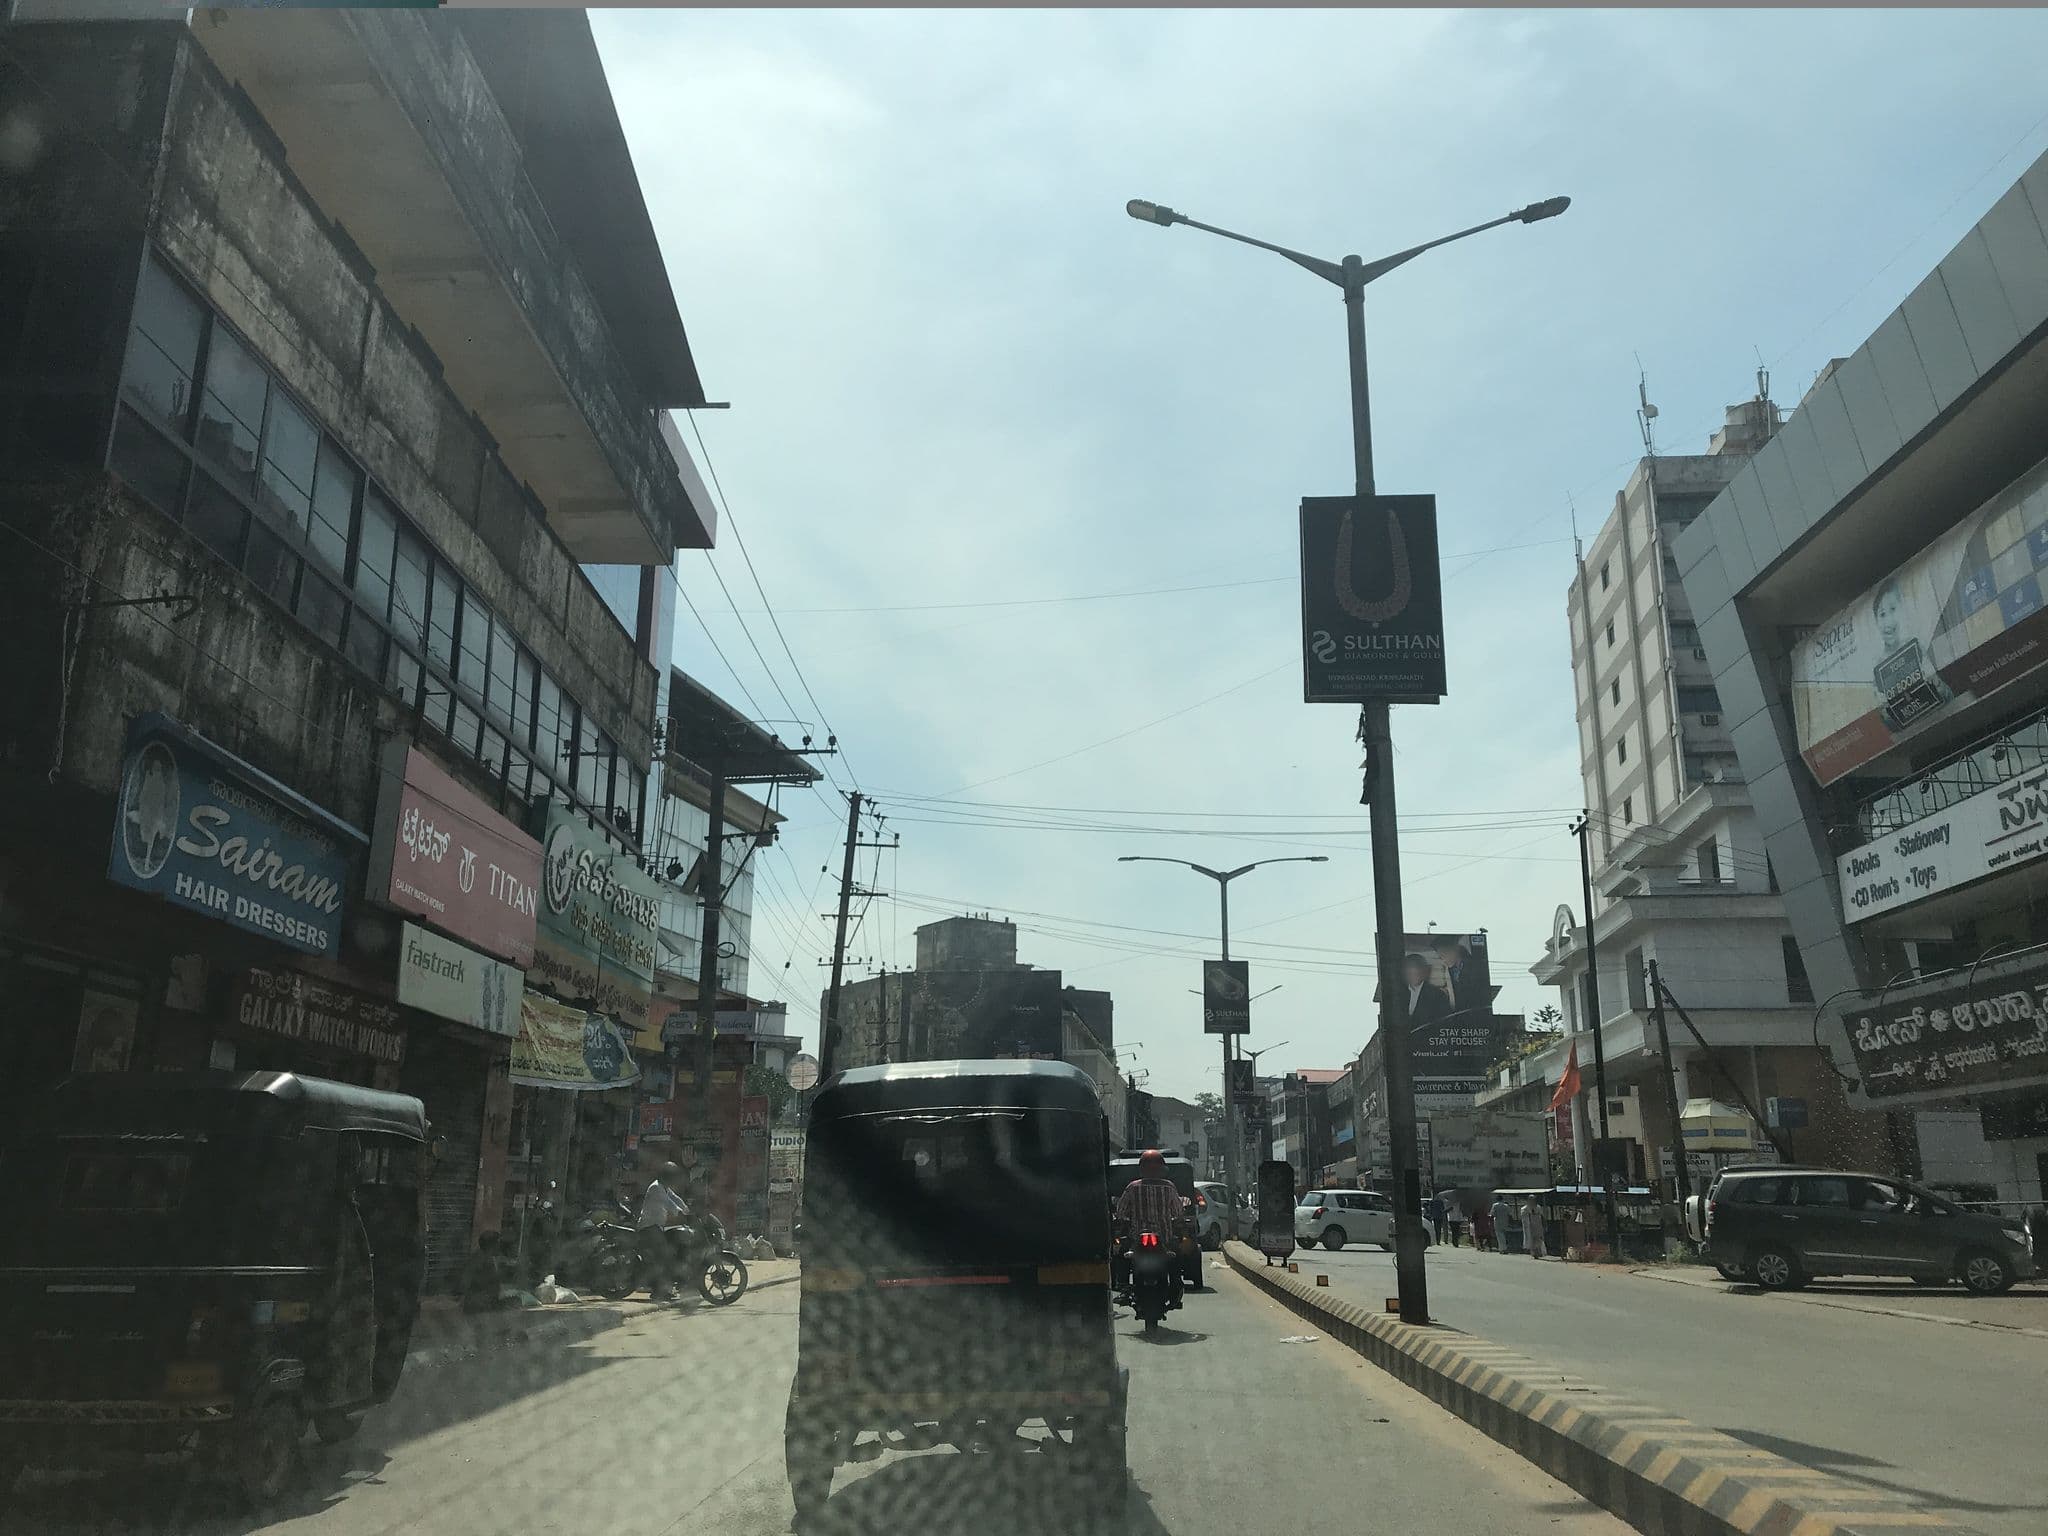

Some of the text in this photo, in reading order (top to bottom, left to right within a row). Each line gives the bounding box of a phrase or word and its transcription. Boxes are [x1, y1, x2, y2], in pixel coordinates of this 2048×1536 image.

[1344, 634, 1440, 649] SULTHAN
[1897, 668, 1921, 692] BOOKS
[1899, 822, 1951, 857] Stationery
[176, 804, 340, 914] Sairam
[1852, 852, 1881, 877] Books
[1910, 864, 1938, 889] Toys
[488, 863, 537, 918] TITAN
[1855, 876, 1900, 908] CD Rom's
[175, 872, 329, 950] HAIR DRESSERS
[1215, 1008, 1248, 1017] SULTHAN
[240, 991, 306, 1038] GALAXY
[309, 1010, 355, 1049] WATCH
[357, 1022, 402, 1063] WORKS
[1440, 1028, 1490, 1037] STAY SHARP
[1429, 1037, 1449, 1046] STAY
[1416, 1083, 1453, 1092] awrence
